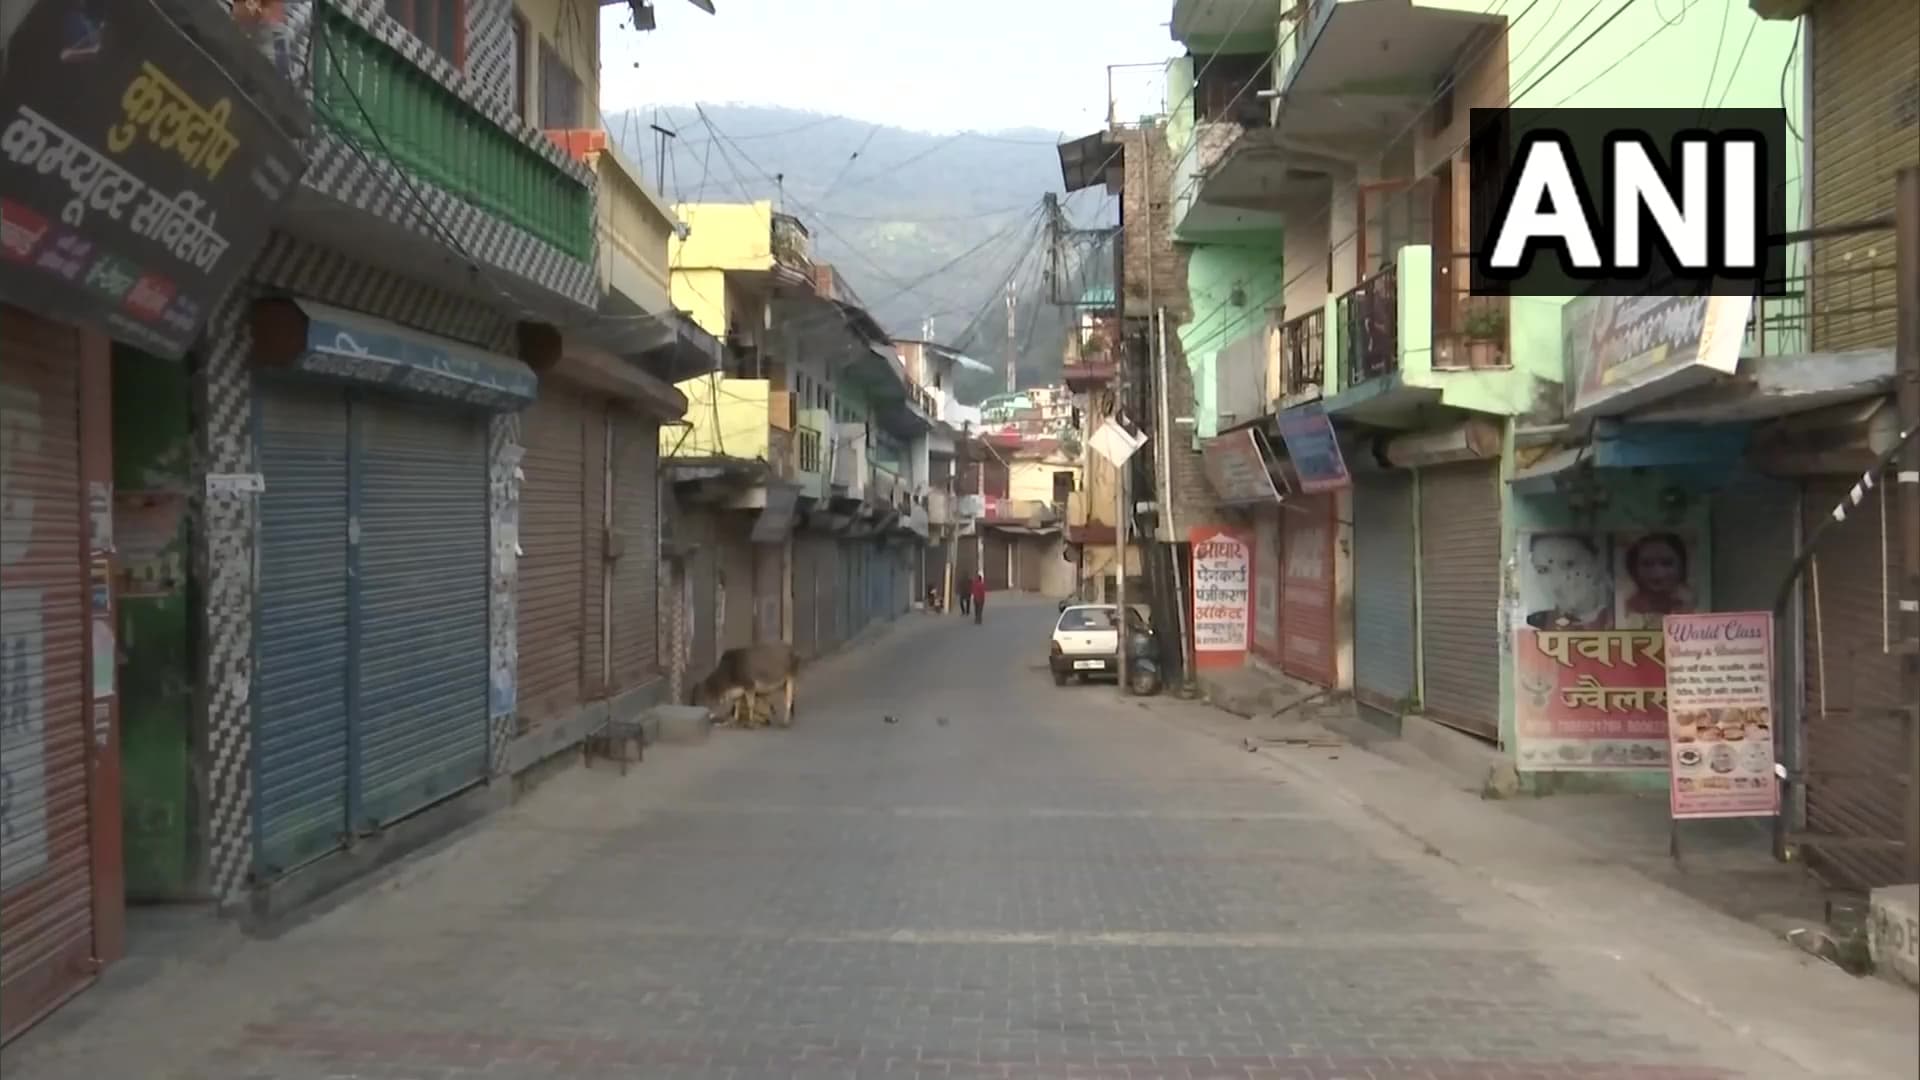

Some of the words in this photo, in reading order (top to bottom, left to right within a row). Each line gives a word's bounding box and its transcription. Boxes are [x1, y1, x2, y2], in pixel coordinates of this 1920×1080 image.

[108, 60, 240, 181] कुलदीप
[2, 105, 145, 226] कम्प्यूटर
[130, 190, 231, 273] सर्विसेज
[1196, 584, 1248, 602] पंजीकरण
[1668, 622, 1719, 642] World
[1725, 620, 1762, 640] Class
